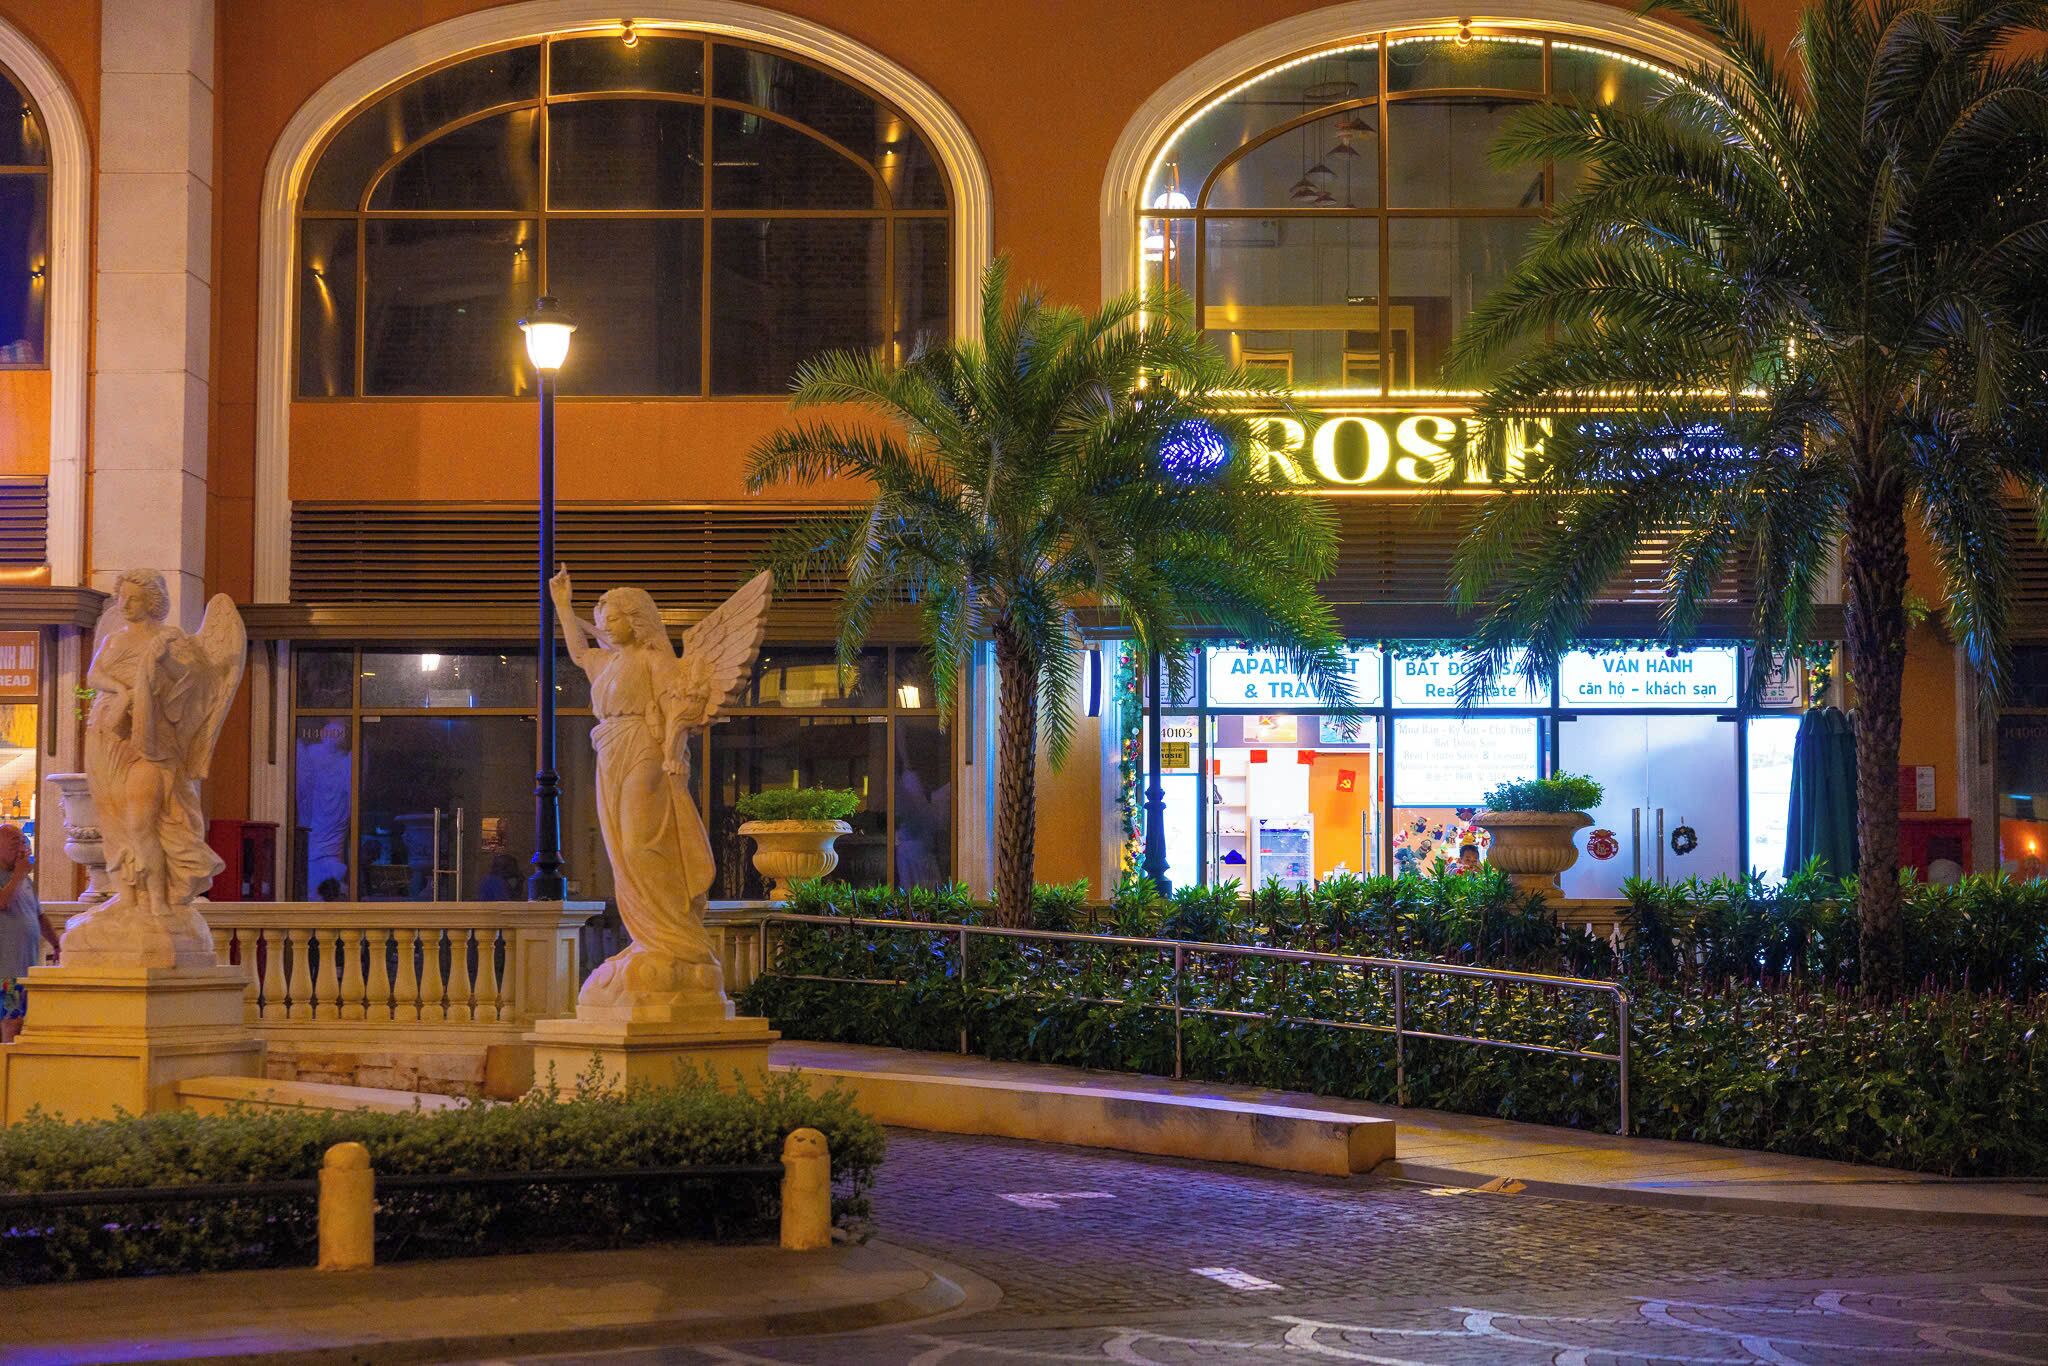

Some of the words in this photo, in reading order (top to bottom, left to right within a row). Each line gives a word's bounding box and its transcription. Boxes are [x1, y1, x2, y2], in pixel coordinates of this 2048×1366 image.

[1248, 415, 1553, 485] ROSIE
[1646, 656, 1693, 673] HÀNH
[1244, 683, 1258, 699] &
[1268, 682, 1336, 698] TRAV
[1646, 681, 1686, 695] khách
